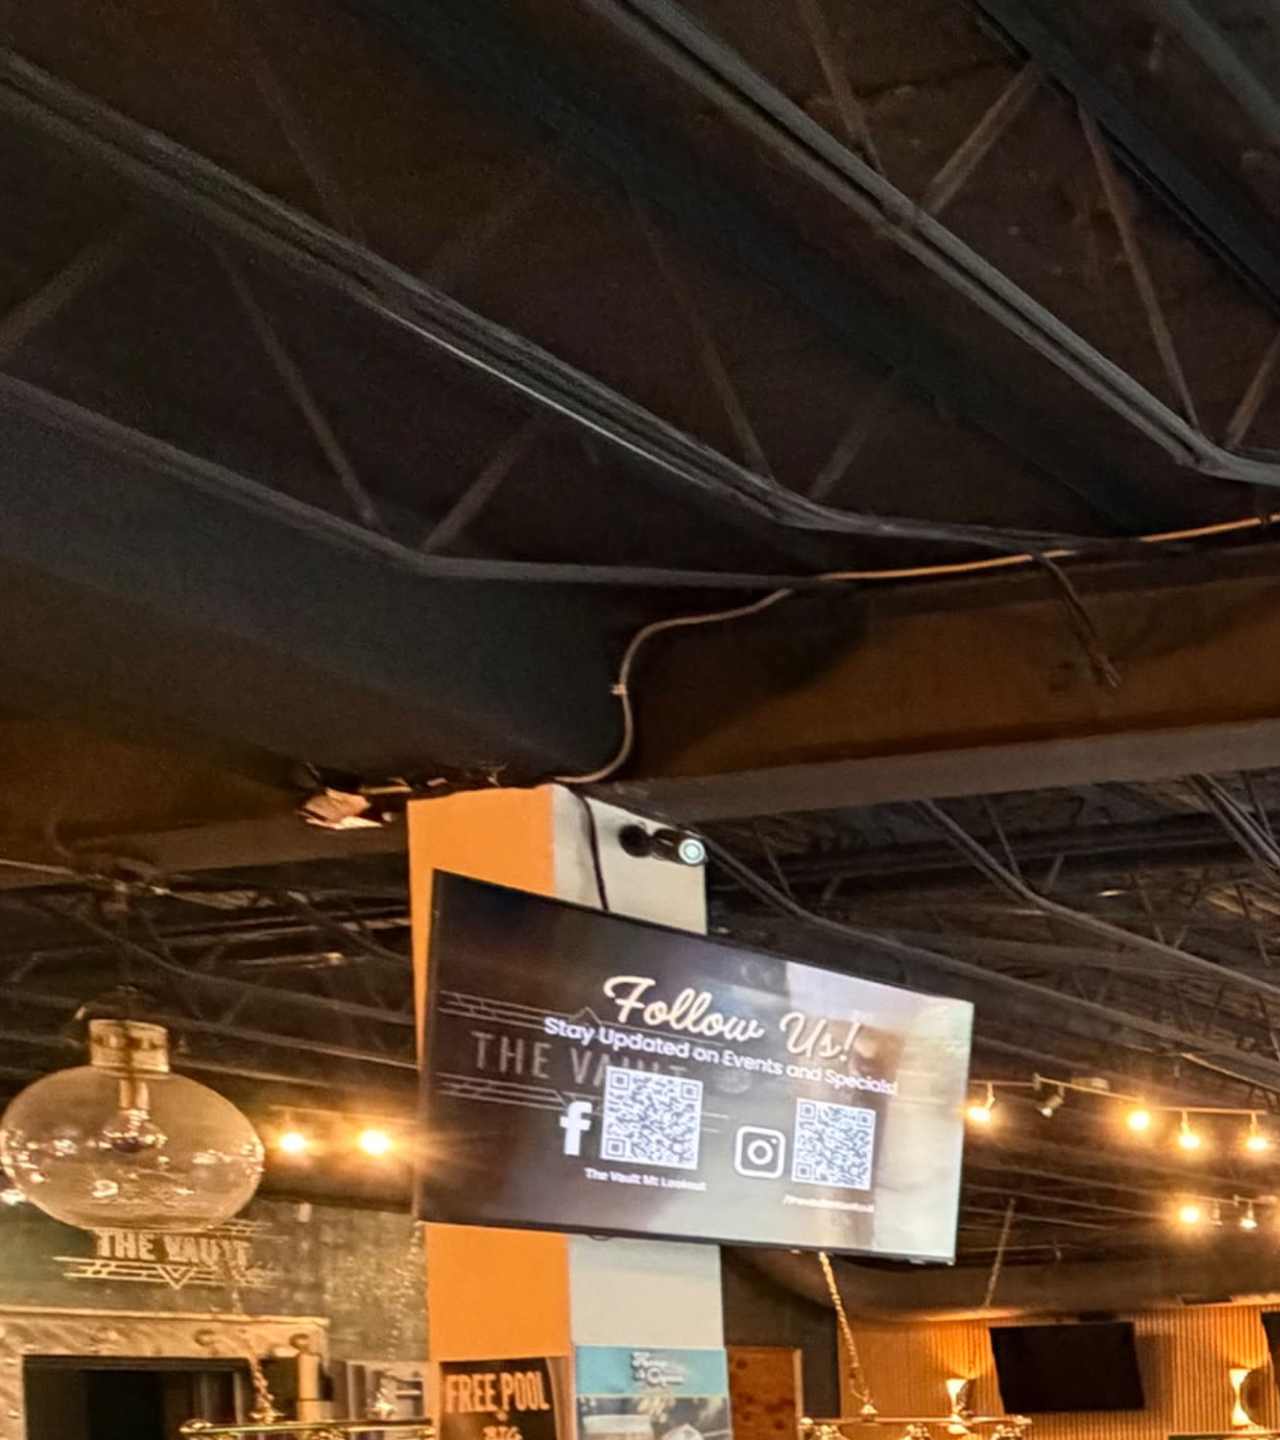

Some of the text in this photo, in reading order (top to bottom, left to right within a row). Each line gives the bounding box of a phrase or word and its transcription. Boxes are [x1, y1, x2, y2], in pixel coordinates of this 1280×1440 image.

[603, 975, 862, 1062] Follow Us!
[471, 1031, 552, 1080] THE
[543, 1016, 597, 1046] Stay
[600, 1026, 691, 1059] Updated
[691, 1047, 720, 1066] on
[722, 1049, 783, 1076] Events
[786, 1064, 822, 1082] and
[96, 1230, 159, 1261] THE
[444, 1370, 551, 1414] FREE POOL
